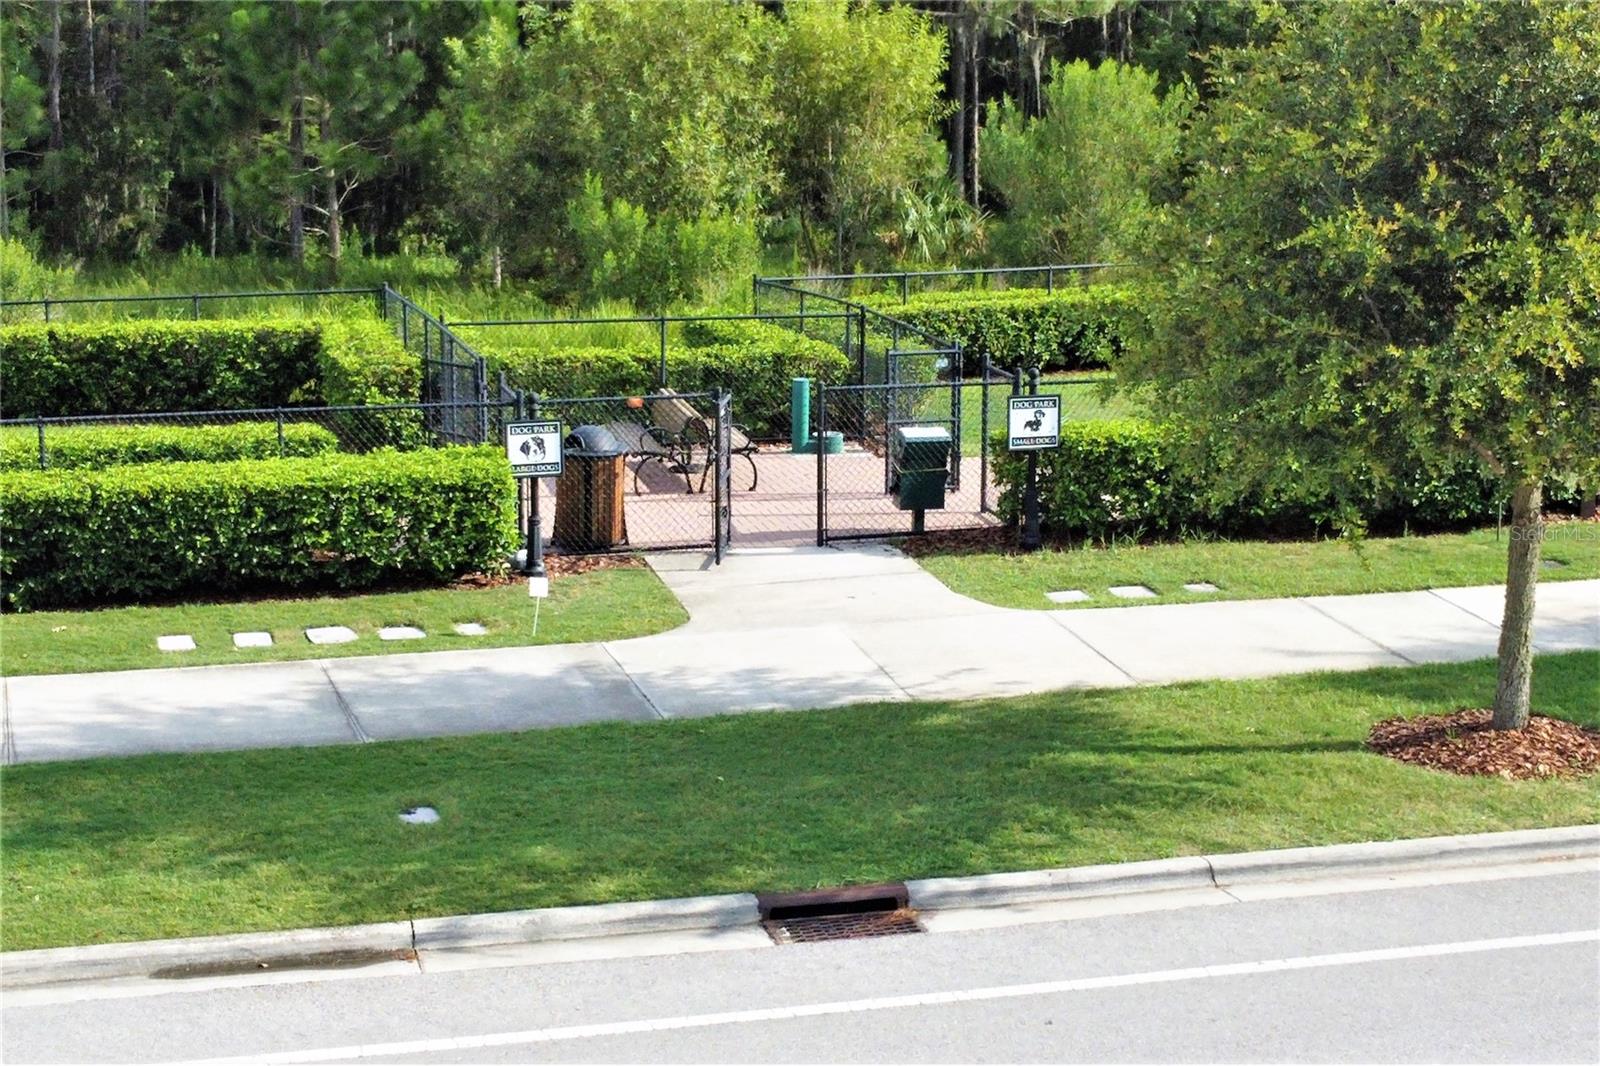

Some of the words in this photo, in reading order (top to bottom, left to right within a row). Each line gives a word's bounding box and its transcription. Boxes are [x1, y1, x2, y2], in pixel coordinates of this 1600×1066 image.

[1013, 400, 1033, 408] DOG
[1034, 400, 1055, 408] PARK
[511, 426, 532, 434] DOG
[532, 425, 556, 433] PARK
